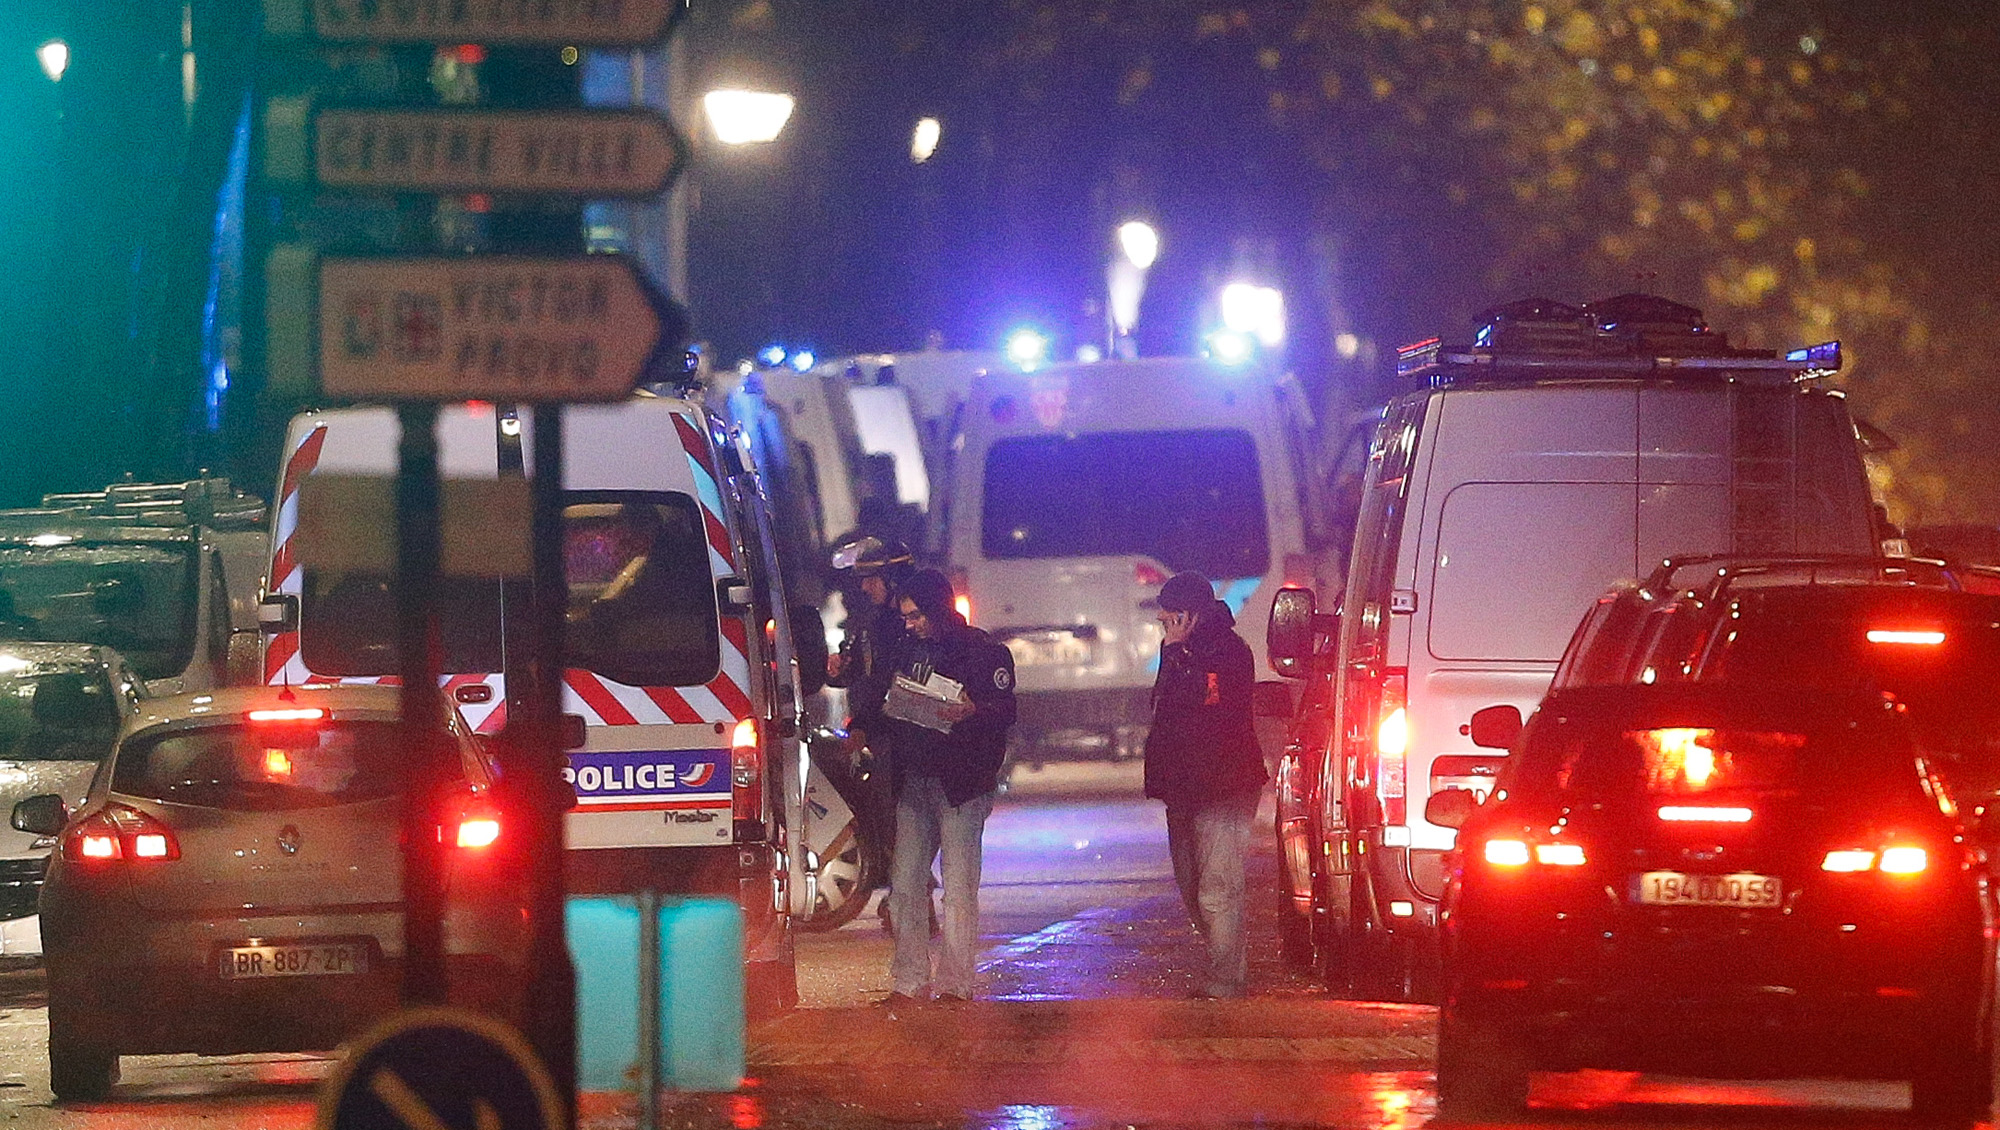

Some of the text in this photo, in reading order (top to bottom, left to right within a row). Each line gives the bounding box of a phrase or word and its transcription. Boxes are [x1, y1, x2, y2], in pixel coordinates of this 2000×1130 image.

[327, 124, 635, 176] CENTRE VILLE
[451, 274, 610, 323] VICTOR
[561, 764, 676, 791] POLICE
